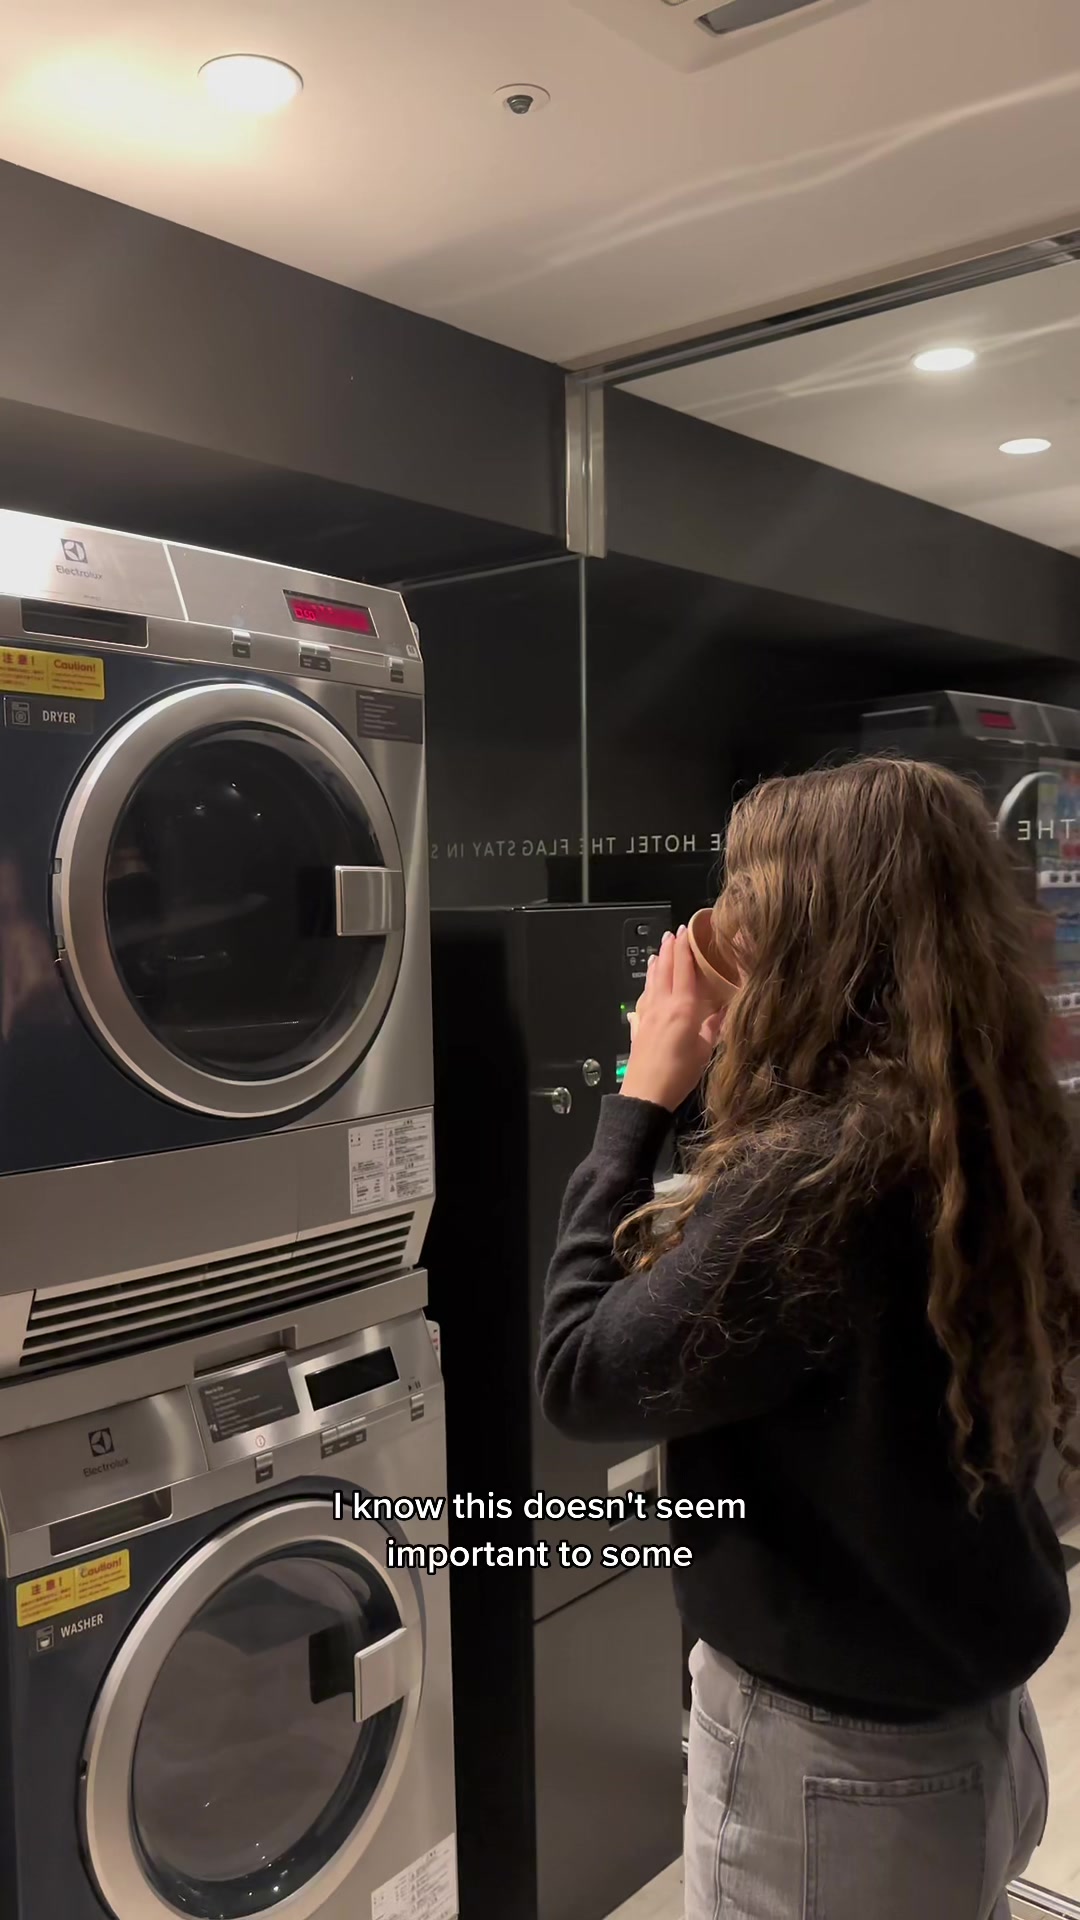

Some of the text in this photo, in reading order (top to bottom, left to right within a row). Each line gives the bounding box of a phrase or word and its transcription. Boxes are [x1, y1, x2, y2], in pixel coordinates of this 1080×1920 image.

[55, 564, 103, 580] Electrolux
[53, 659, 97, 673] Caution!
[42, 710, 76, 724] DRYER
[83, 1457, 129, 1477] Electrolux
[79, 1556, 122, 1579] Caution!
[60, 1613, 104, 1639] WASHER
